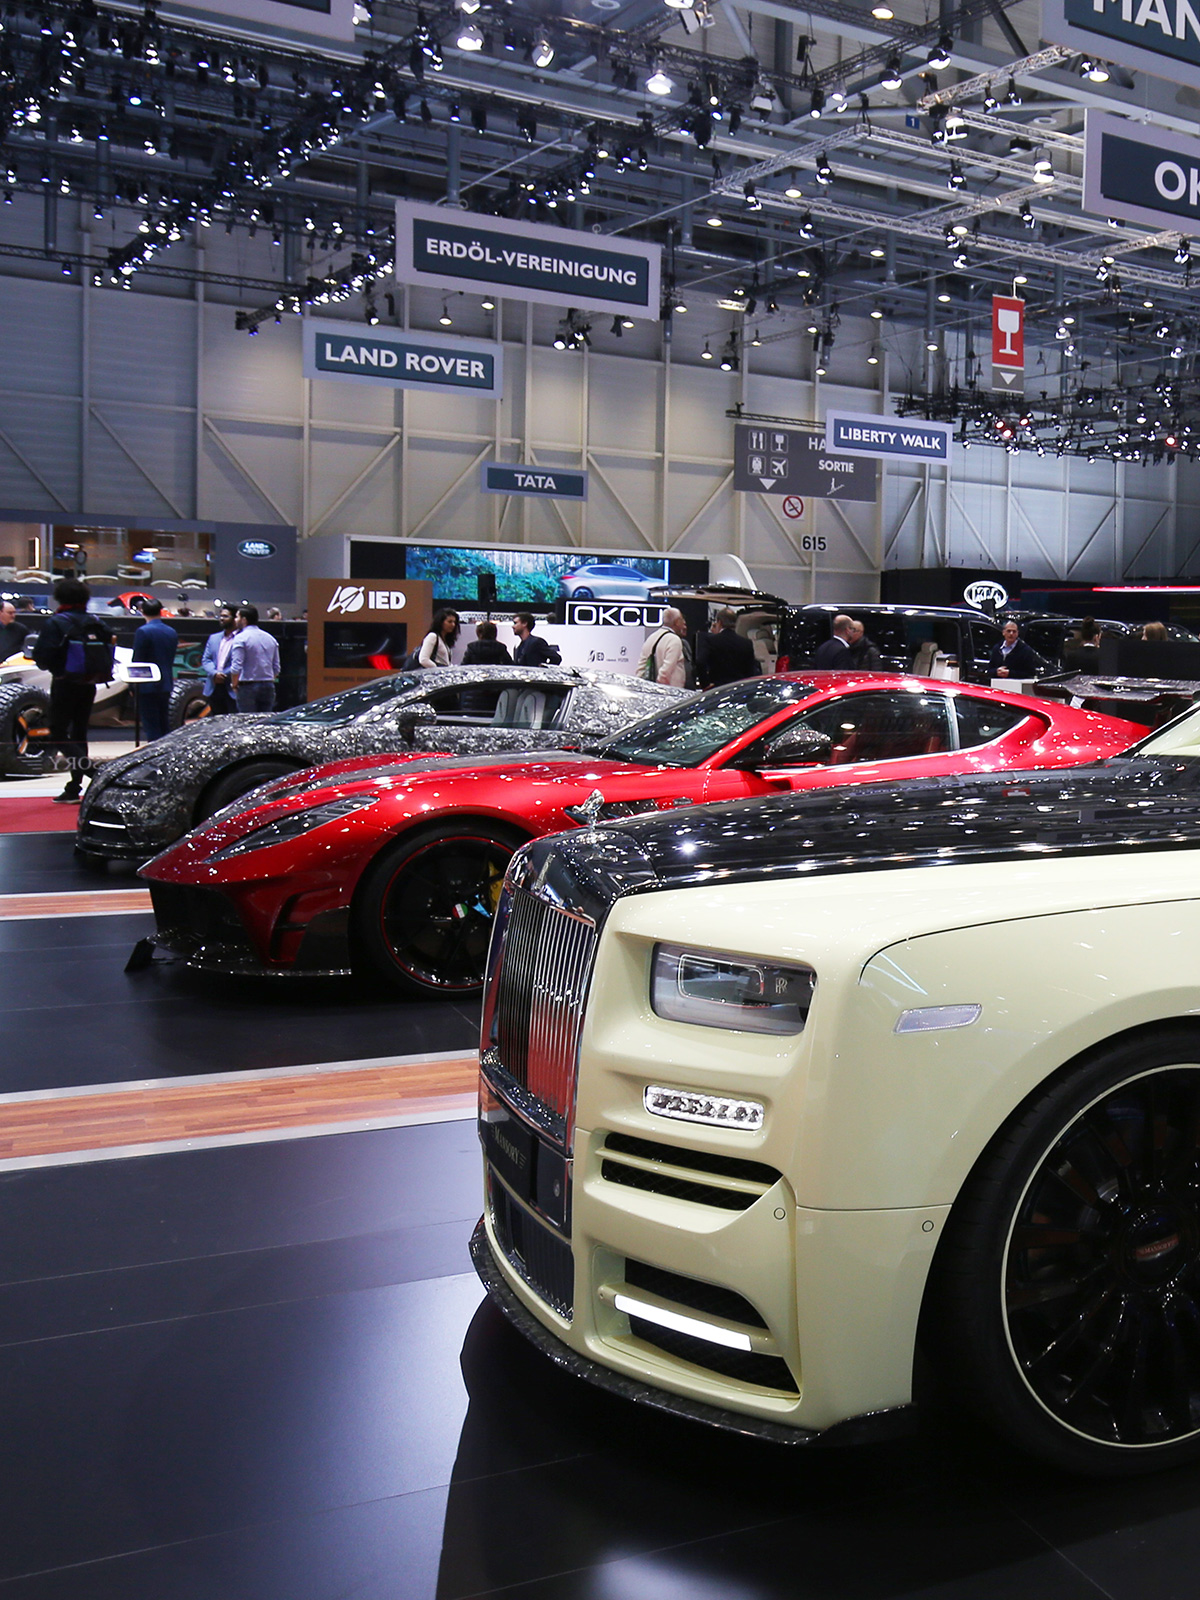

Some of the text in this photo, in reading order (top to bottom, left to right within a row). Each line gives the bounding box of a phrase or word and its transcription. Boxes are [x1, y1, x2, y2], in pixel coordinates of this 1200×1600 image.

[426, 238, 637, 286] ERDÖL-VEREINIGUNG
[325, 343, 485, 379] LAND ROVER
[839, 427, 897, 445] LIBERTY
[900, 433, 941, 449] WALK
[818, 459, 855, 473] SORTIE
[514, 474, 557, 490] TATA
[802, 536, 827, 551] 615
[368, 591, 406, 609] IED
[574, 606, 663, 627] OKCU
